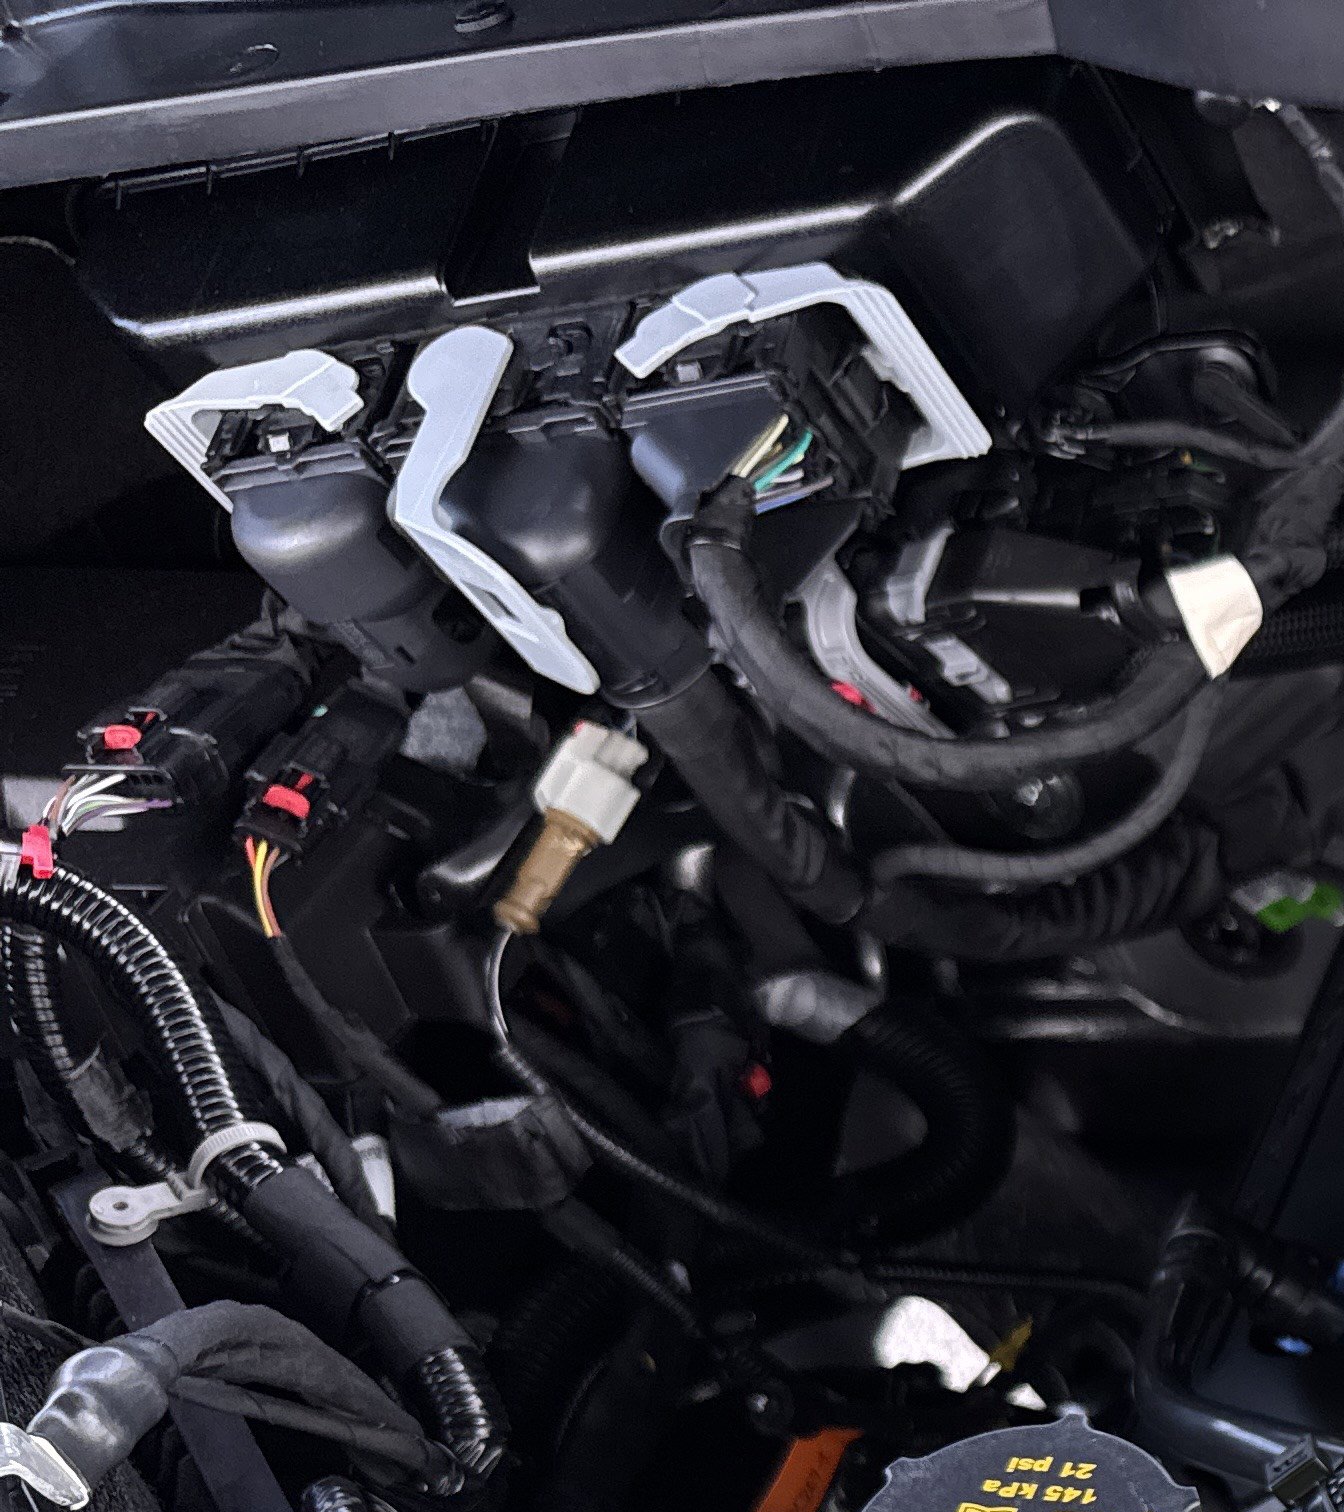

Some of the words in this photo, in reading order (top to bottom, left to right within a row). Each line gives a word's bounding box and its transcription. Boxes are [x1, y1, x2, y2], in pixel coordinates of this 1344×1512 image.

[1005, 1456, 1054, 1473] psi
[1059, 1462, 1098, 1479] 21
[982, 1479, 1039, 1500] kPa
[1043, 1485, 1098, 1505] 145
